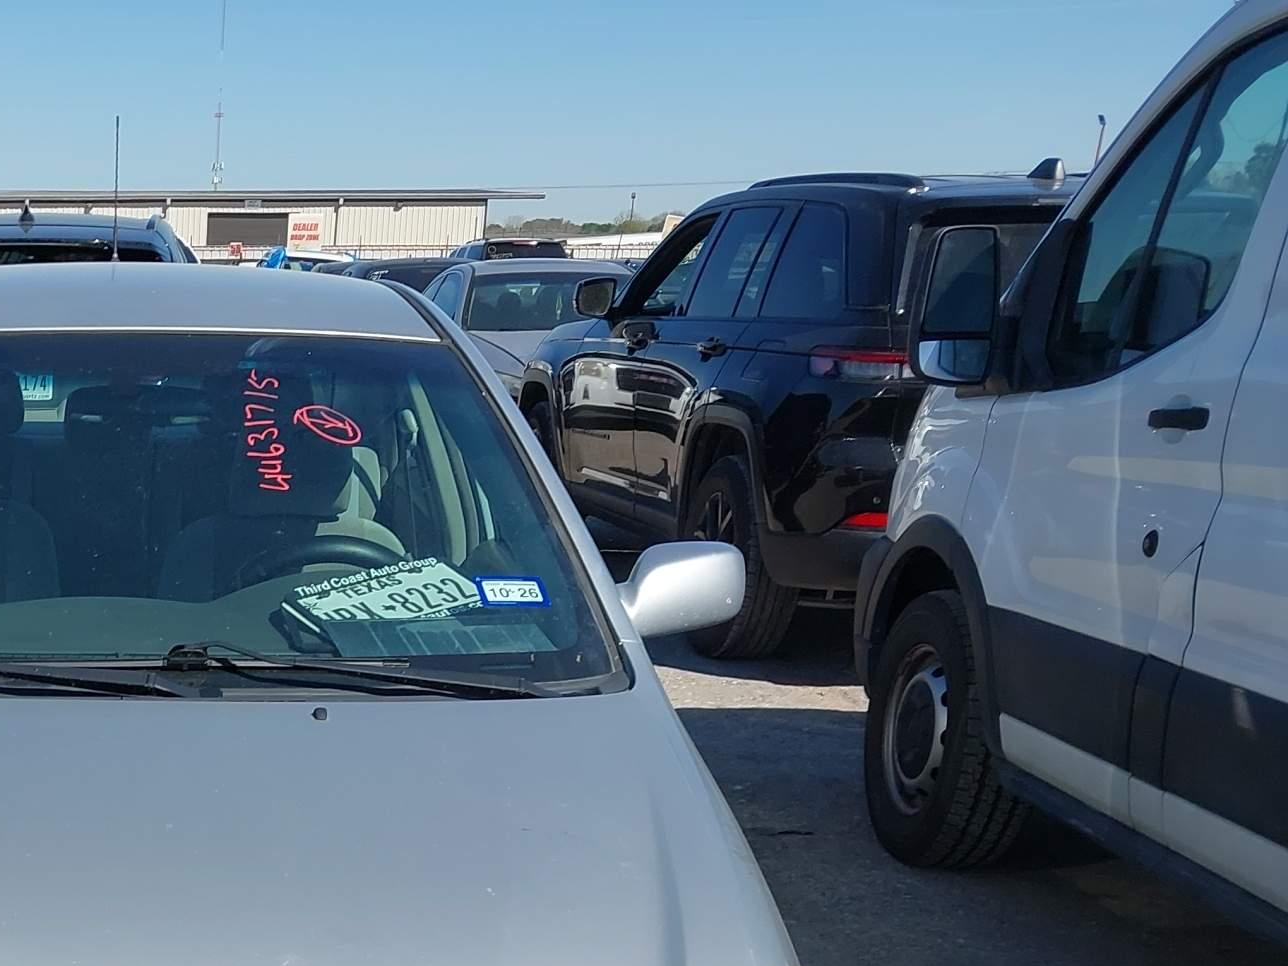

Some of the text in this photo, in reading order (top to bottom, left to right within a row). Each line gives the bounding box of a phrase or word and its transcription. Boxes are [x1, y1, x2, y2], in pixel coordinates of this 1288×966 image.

[292, 223, 319, 231] DEALER
[244, 368, 293, 491] 44631715
[294, 556, 438, 597] Third Coast Auto Group
[336, 575, 404, 599] TEXAS
